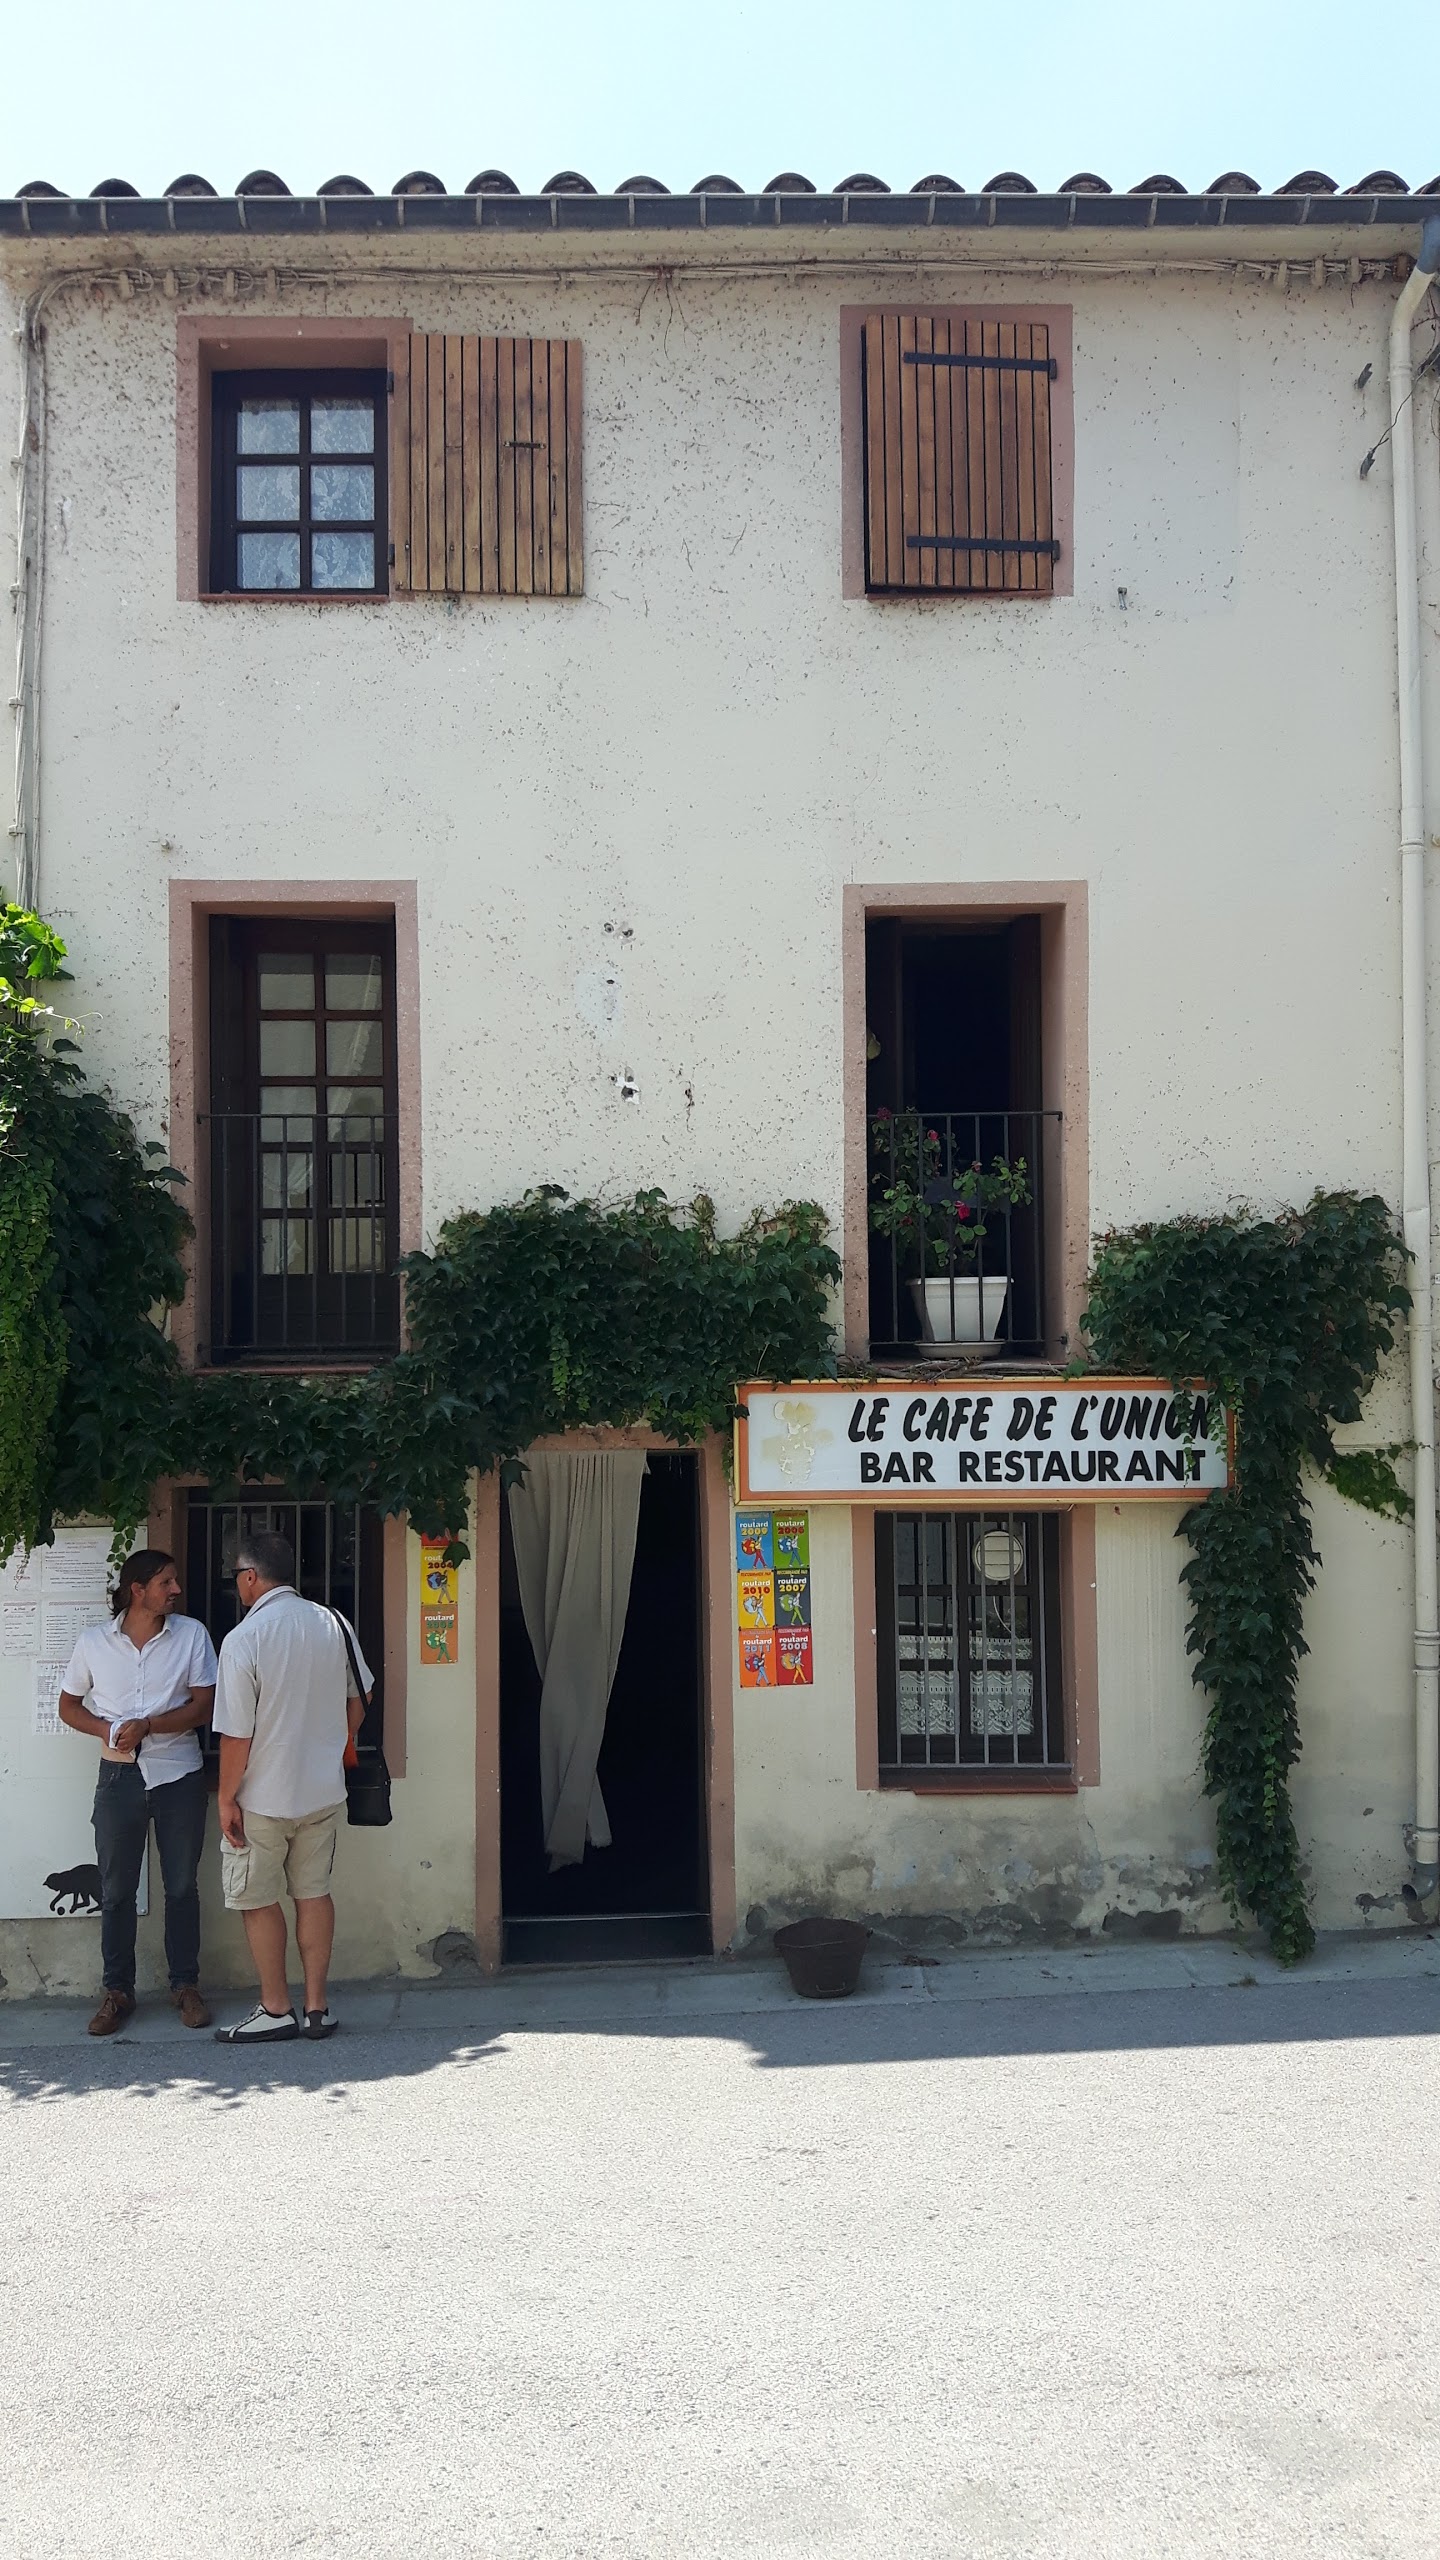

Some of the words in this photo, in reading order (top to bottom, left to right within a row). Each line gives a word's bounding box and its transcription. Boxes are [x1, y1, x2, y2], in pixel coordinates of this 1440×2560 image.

[848, 1398, 889, 1442] LE
[903, 1397, 993, 1442] CAFE
[1007, 1397, 1058, 1442] DE
[860, 1451, 936, 1483] BAR
[959, 1450, 1206, 1482] RESTAURANT
[741, 1528, 768, 1536] 2009
[779, 1584, 806, 1592] 2007
